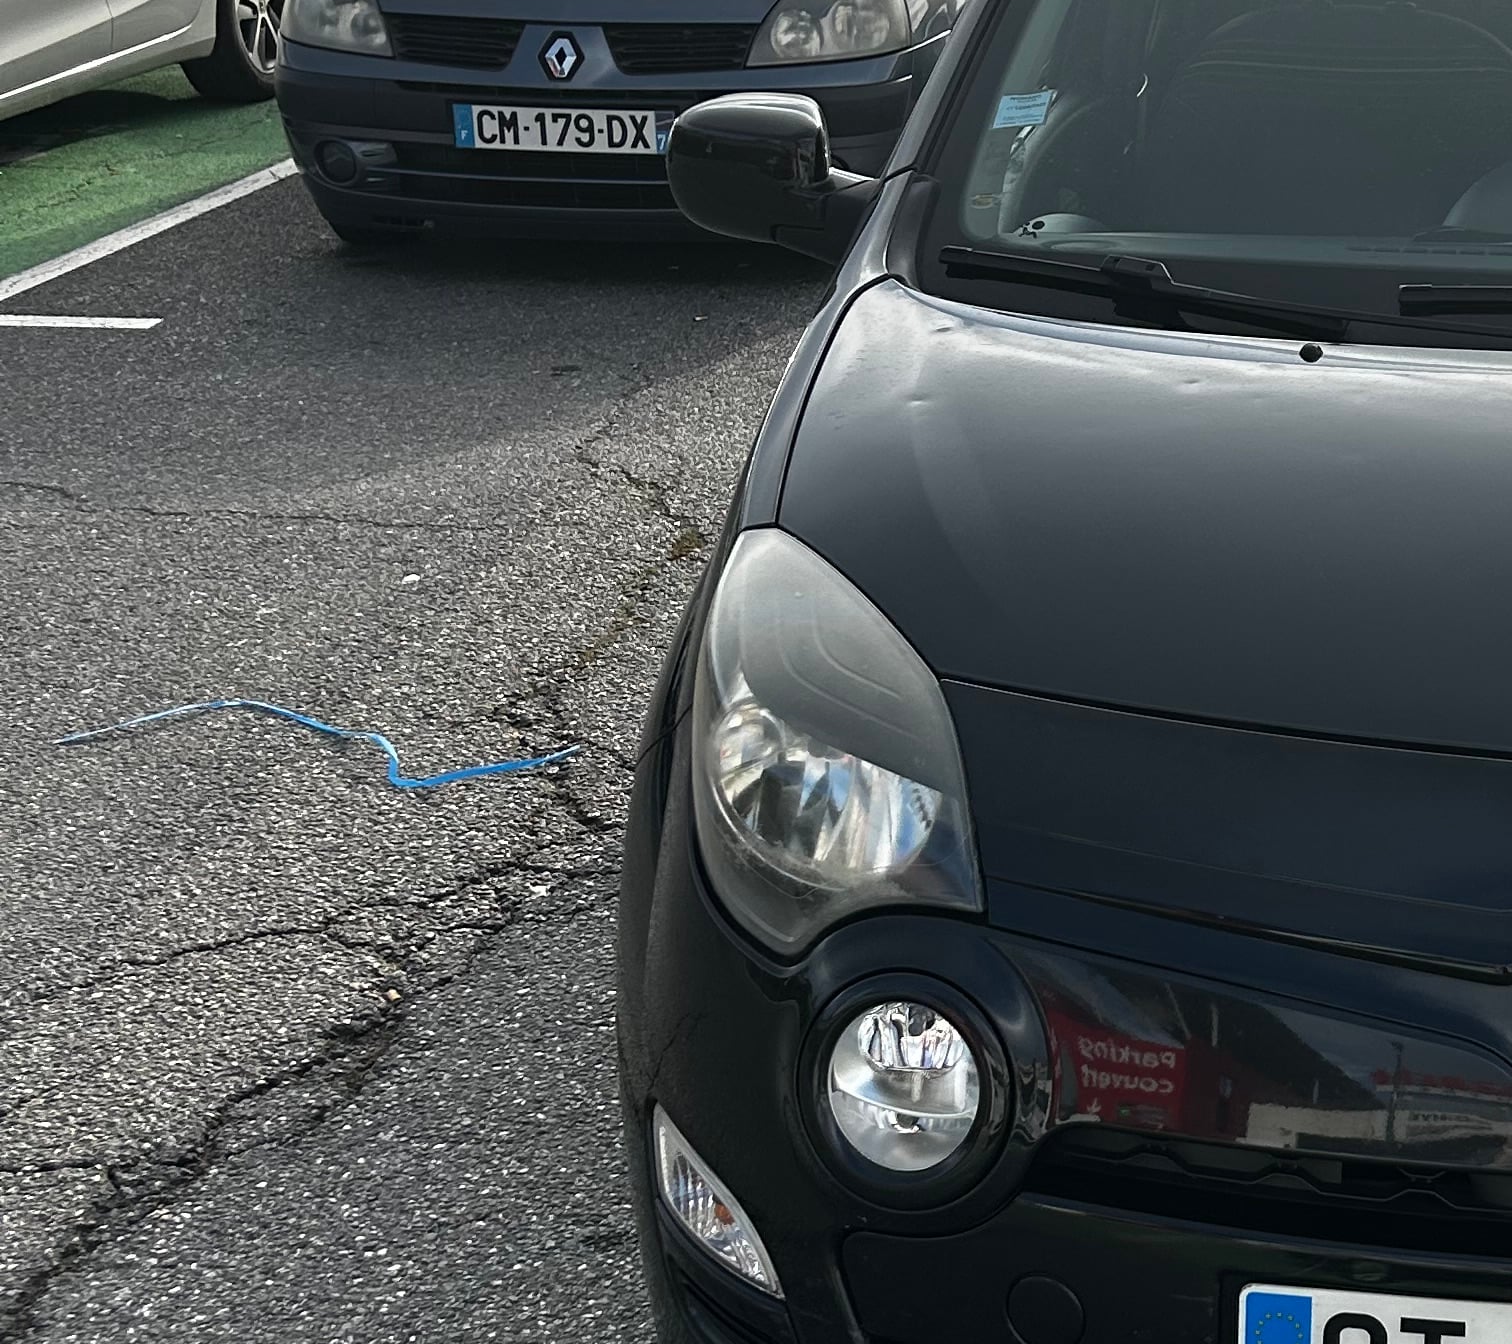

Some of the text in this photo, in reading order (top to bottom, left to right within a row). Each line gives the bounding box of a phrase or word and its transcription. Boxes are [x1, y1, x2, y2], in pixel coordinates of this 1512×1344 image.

[461, 130, 468, 140] F
[476, 109, 651, 149] CM-179-DX
[657, 134, 668, 150] 7
